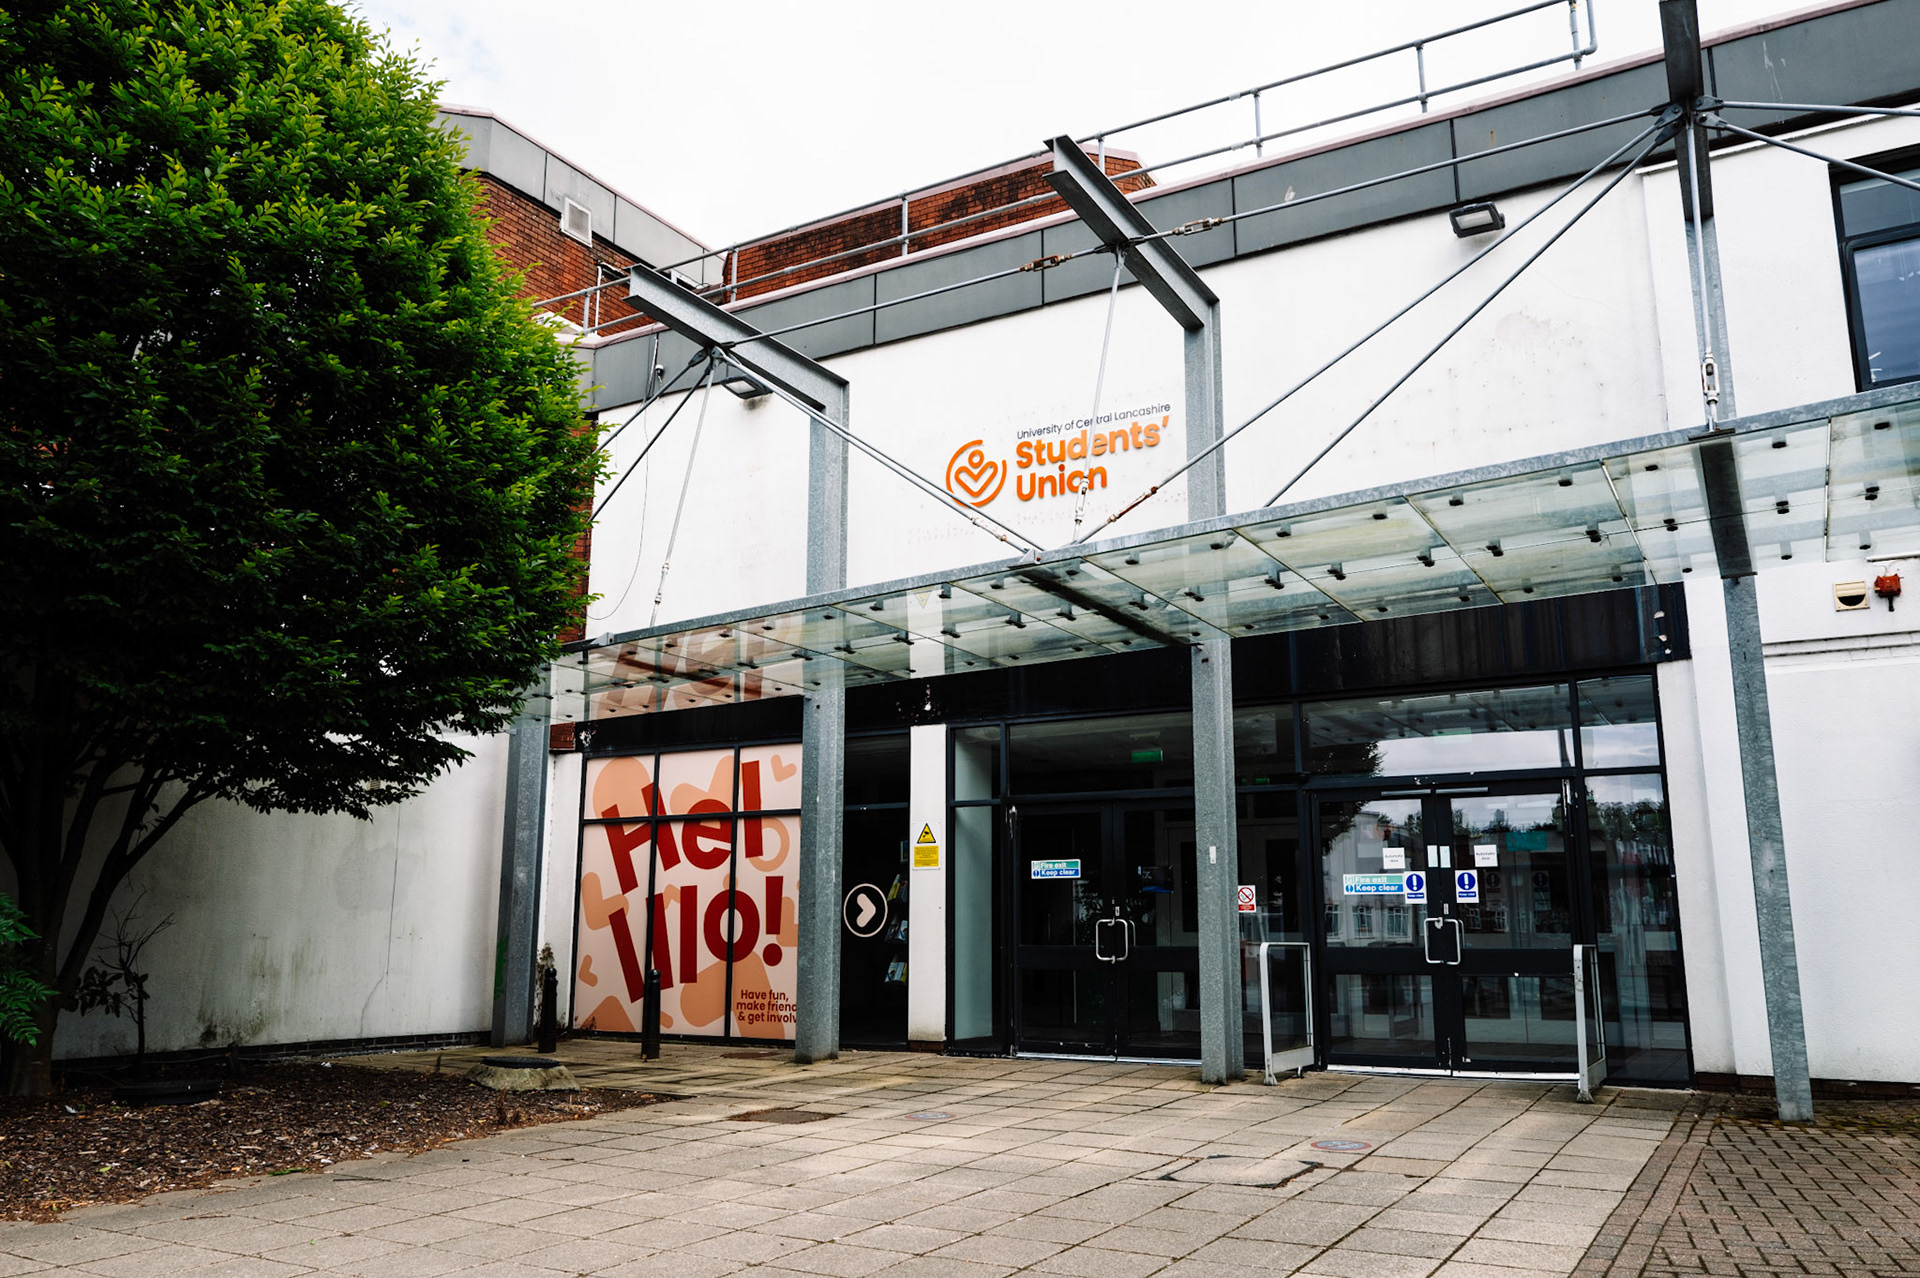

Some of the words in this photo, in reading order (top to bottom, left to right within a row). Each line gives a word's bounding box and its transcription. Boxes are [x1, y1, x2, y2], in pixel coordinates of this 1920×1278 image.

[1016, 423, 1063, 440] University
[1064, 420, 1075, 431] of
[1114, 402, 1171, 421] Lancashire
[1016, 415, 1170, 468] Students'
[1016, 464, 1108, 502] Union
[736, 1000, 766, 1011] make
[740, 989, 767, 1000] Have
[768, 989, 789, 1002] fun,
[737, 1011, 746, 1021] &
[747, 1012, 765, 1025] get
